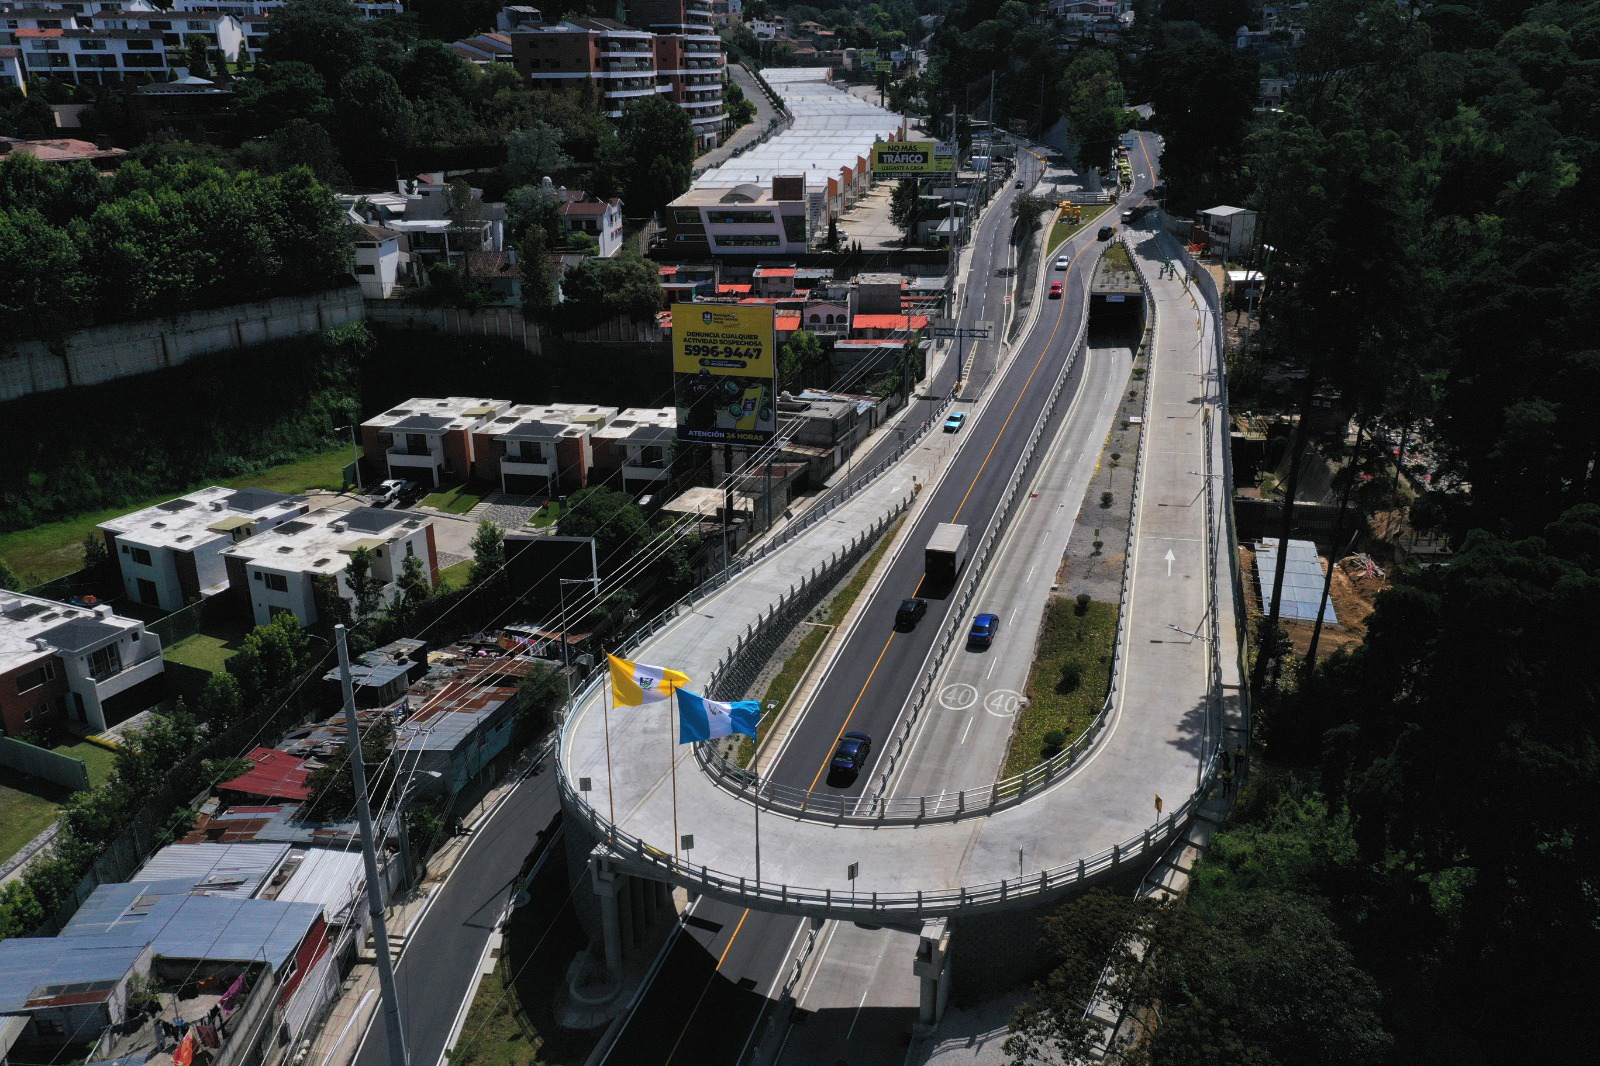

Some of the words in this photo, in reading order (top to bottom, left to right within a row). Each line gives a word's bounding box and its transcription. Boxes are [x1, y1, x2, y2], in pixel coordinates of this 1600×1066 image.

[883, 152, 923, 163] TRÁFICO
[684, 345, 762, 359] 5996-9447
[944, 687, 972, 705] 40
[990, 694, 1018, 713] 40
